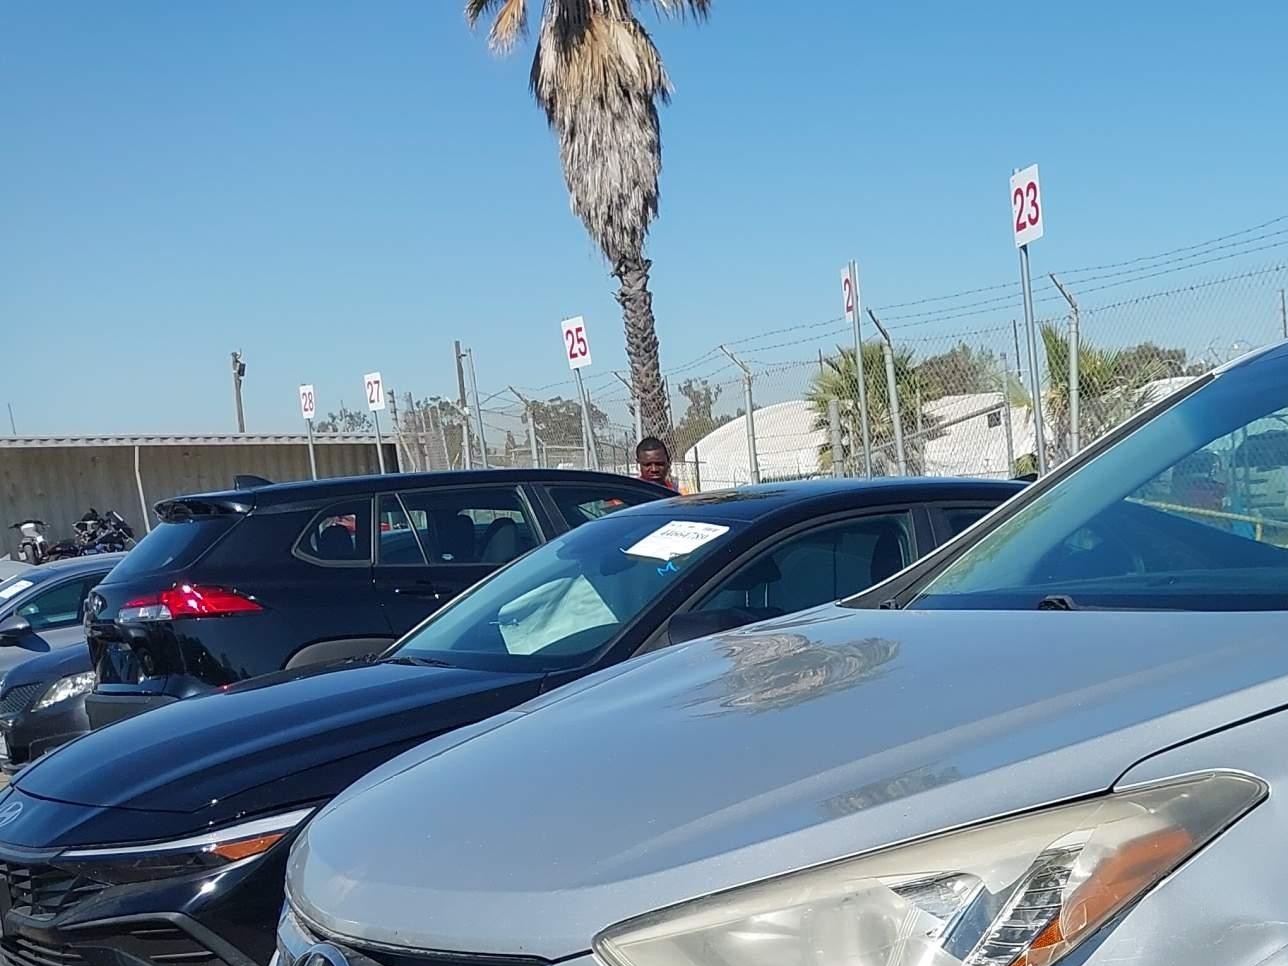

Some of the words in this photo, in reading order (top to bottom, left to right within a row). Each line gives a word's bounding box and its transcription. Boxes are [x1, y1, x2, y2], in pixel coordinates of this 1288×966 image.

[1013, 181, 1040, 232] 23
[566, 327, 588, 359] 25
[302, 392, 314, 411] 28
[367, 380, 380, 403] 27
